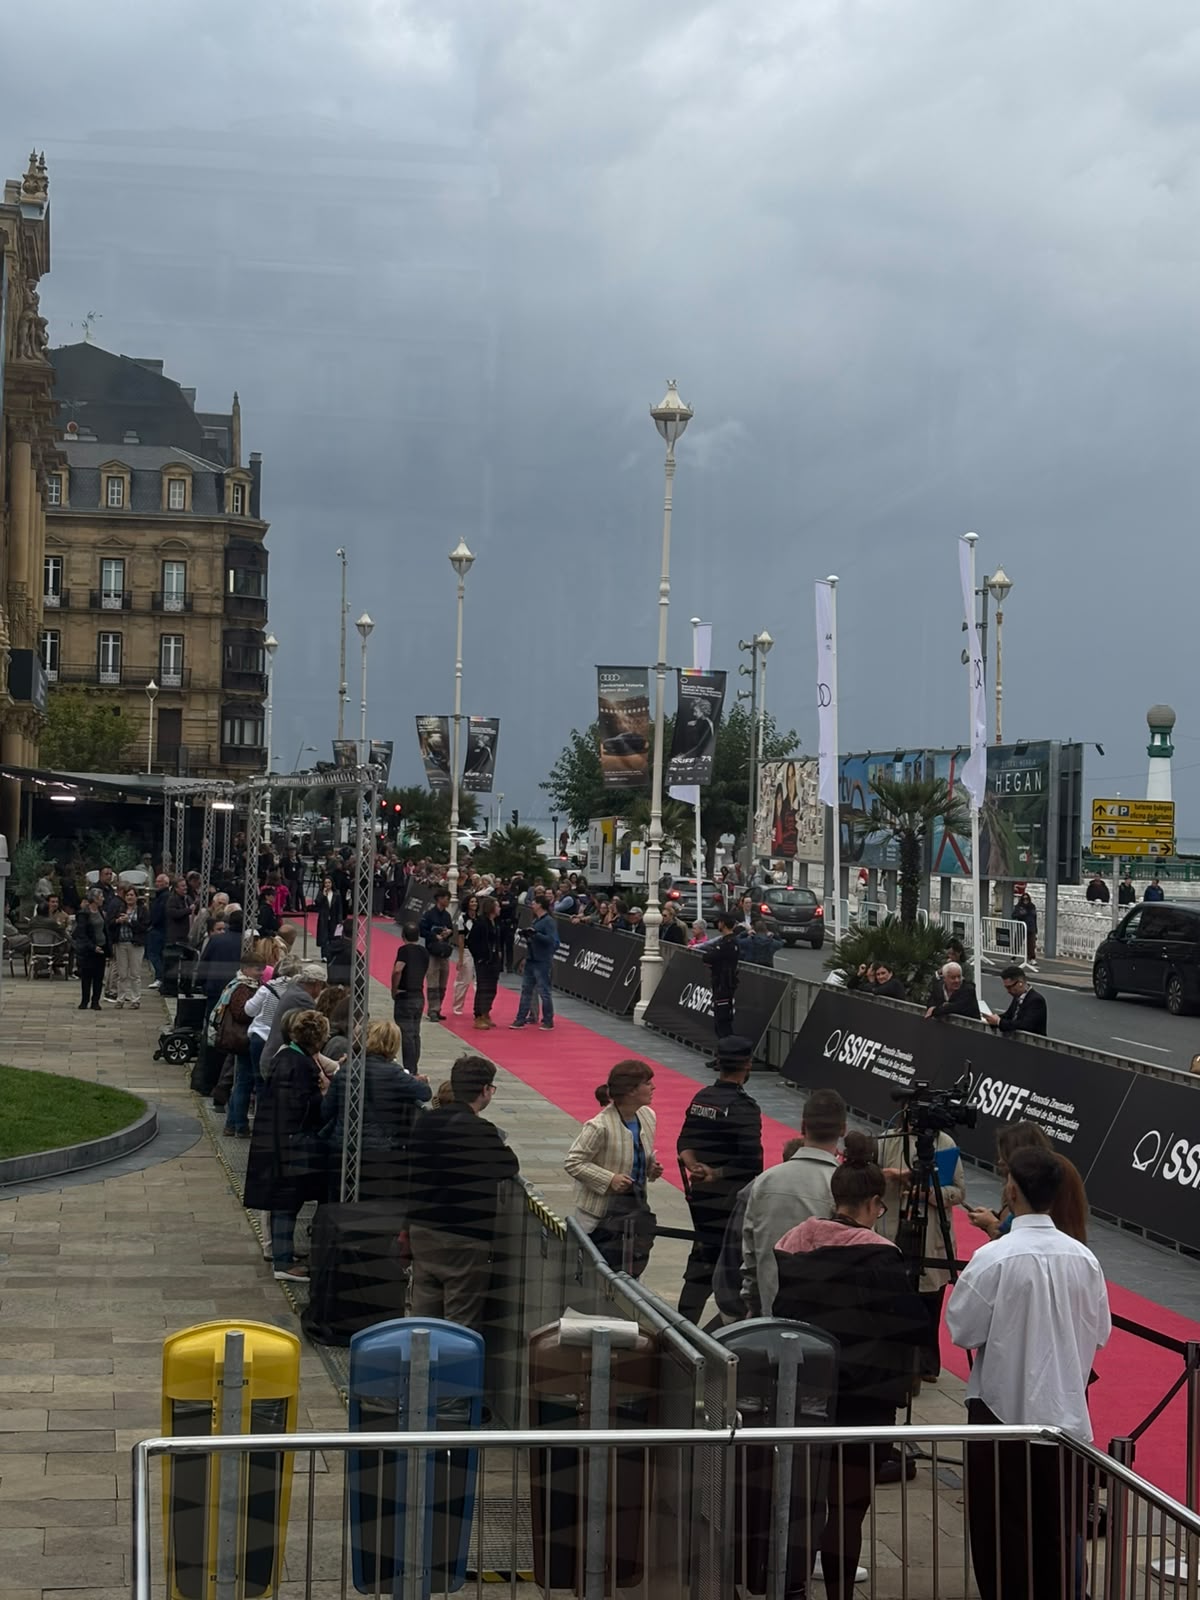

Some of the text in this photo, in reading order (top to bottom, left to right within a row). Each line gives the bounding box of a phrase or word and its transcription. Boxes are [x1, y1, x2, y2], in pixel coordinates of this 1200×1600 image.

[995, 771, 1042, 793] HEGAN
[838, 1033, 882, 1070] SSIFF
[973, 1077, 1030, 1121] SSIFF
[1030, 1092, 1075, 1114] Donostia Zinemaldia
[1023, 1104, 1043, 1118] Festival
[1040, 1108, 1048, 1120] de
[1046, 1111, 1057, 1123] San
[1044, 1125, 1075, 1144] Film Festival
